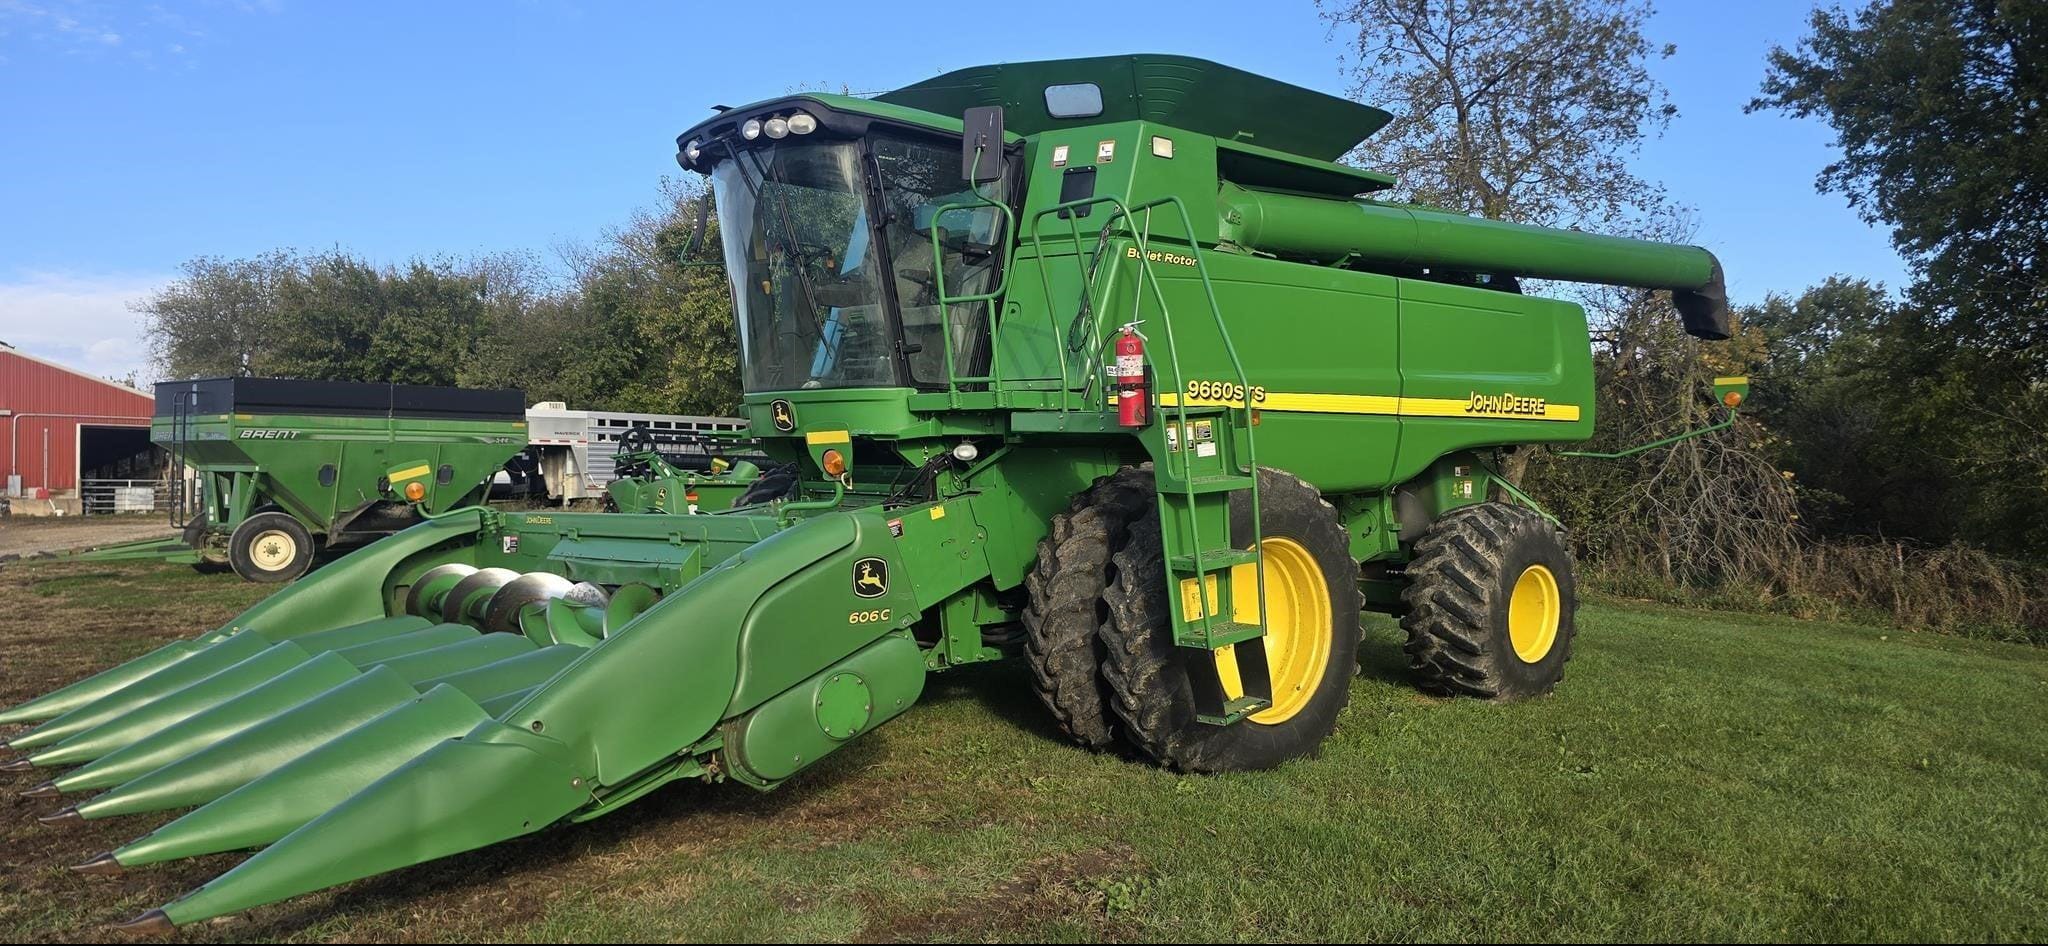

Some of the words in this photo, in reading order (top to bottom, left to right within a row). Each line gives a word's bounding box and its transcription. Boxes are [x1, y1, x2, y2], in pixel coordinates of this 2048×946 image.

[1127, 247, 1162, 262] Bulet
[1164, 253, 1198, 267] Rotor
[239, 429, 301, 440] BRENT
